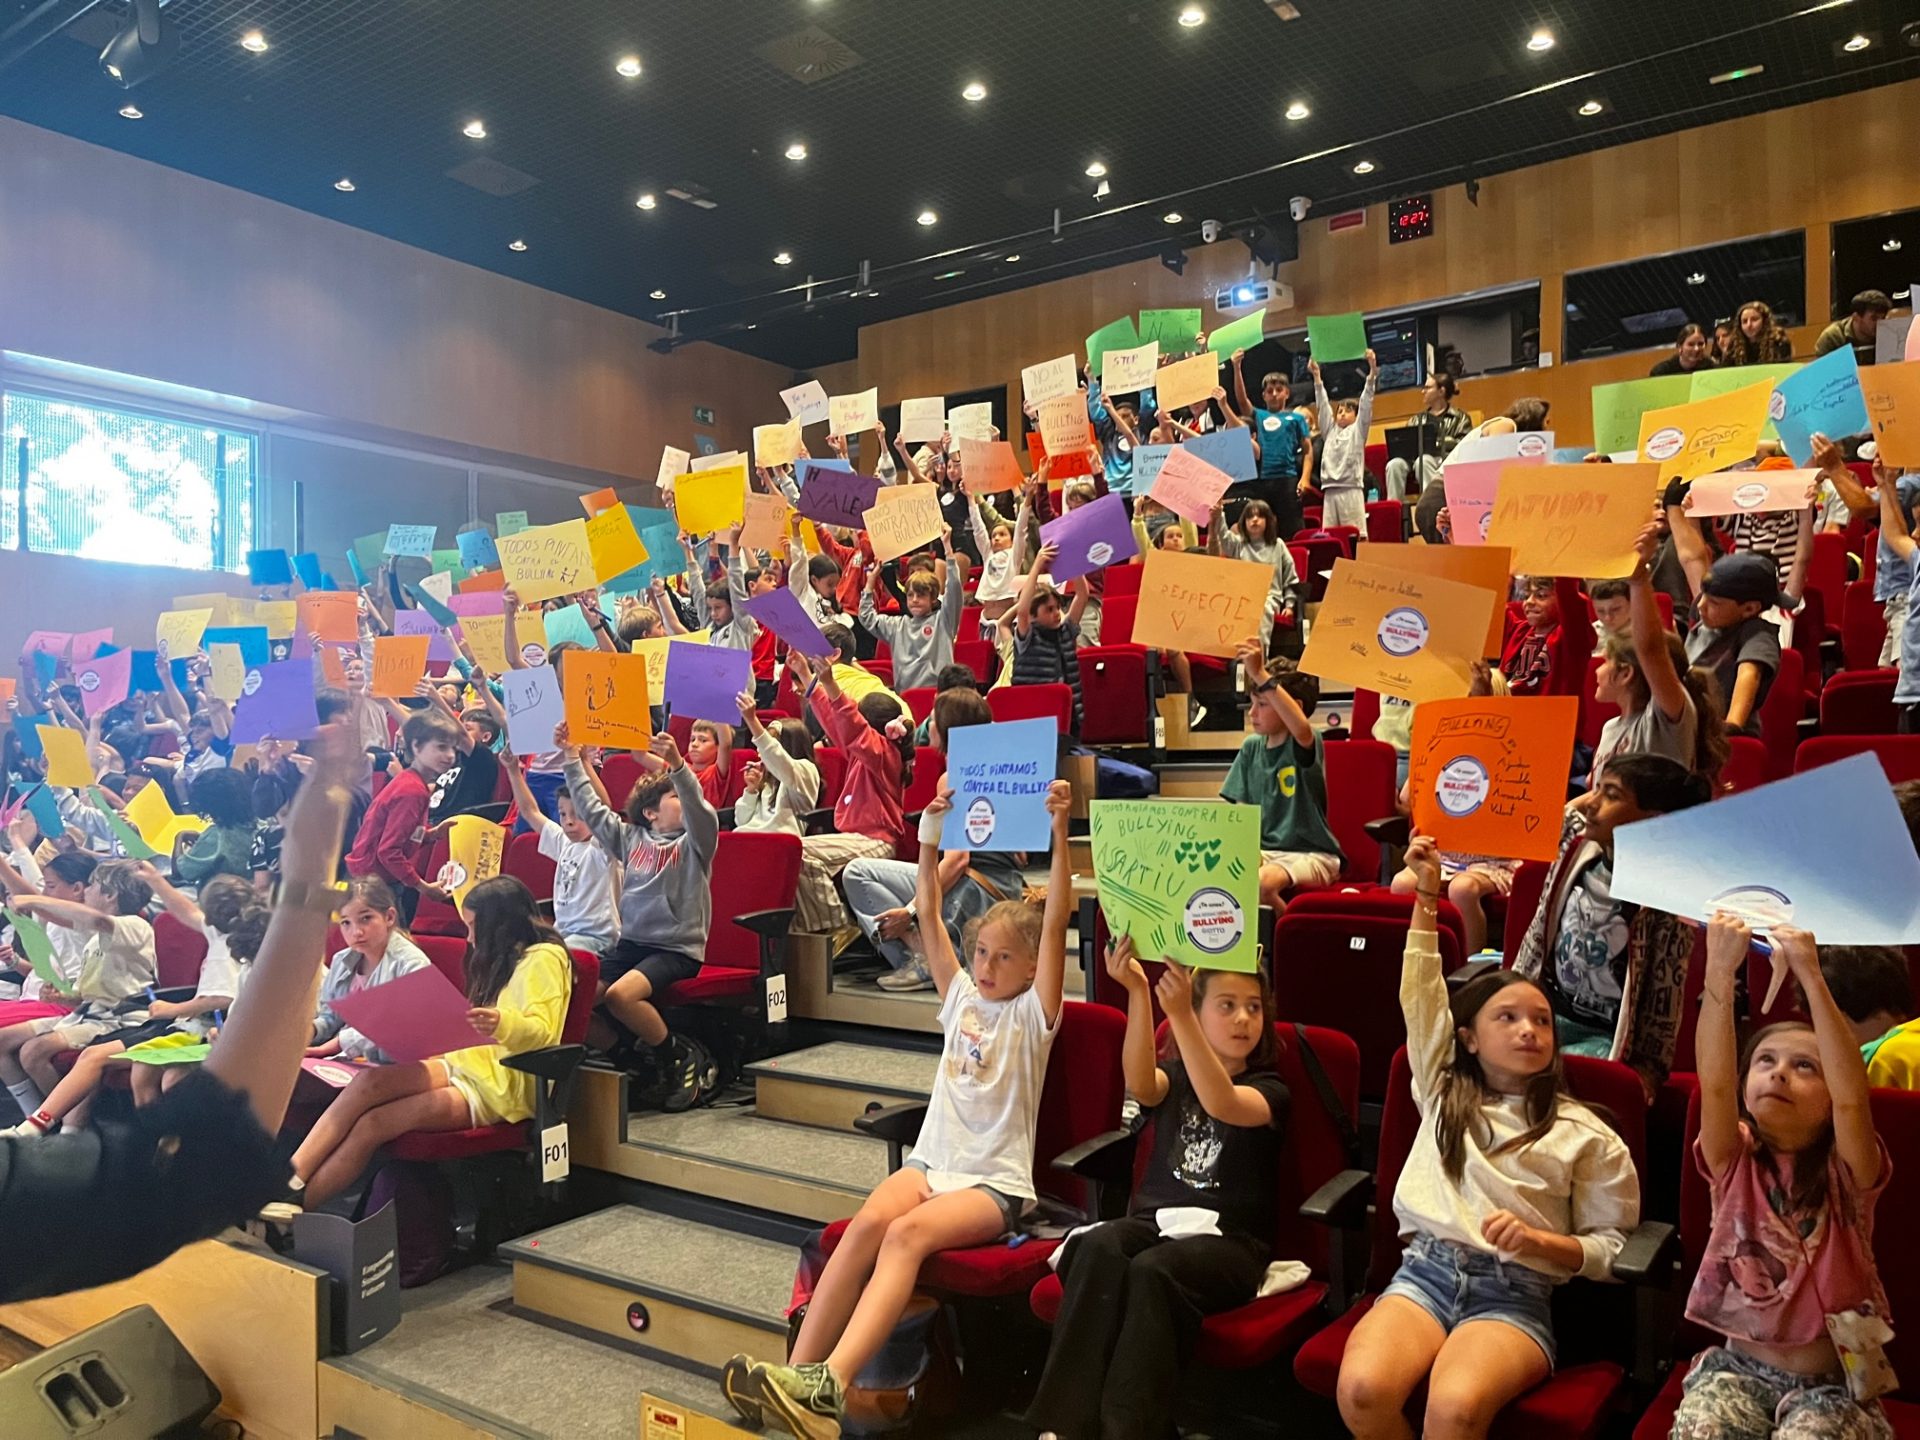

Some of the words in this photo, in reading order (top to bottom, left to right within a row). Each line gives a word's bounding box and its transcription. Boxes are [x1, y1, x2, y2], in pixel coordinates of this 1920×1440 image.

[806, 489, 862, 516] VALE
[503, 539, 540, 555] TODOS
[963, 780, 995, 794] CONTRA
[998, 781, 1010, 795] EL
[1171, 805, 1218, 824] CONTRA
[1228, 810, 1244, 823] EL
[1192, 915, 1235, 928] BULLYING
[768, 989, 785, 1008] F02
[544, 1141, 567, 1165] F01
